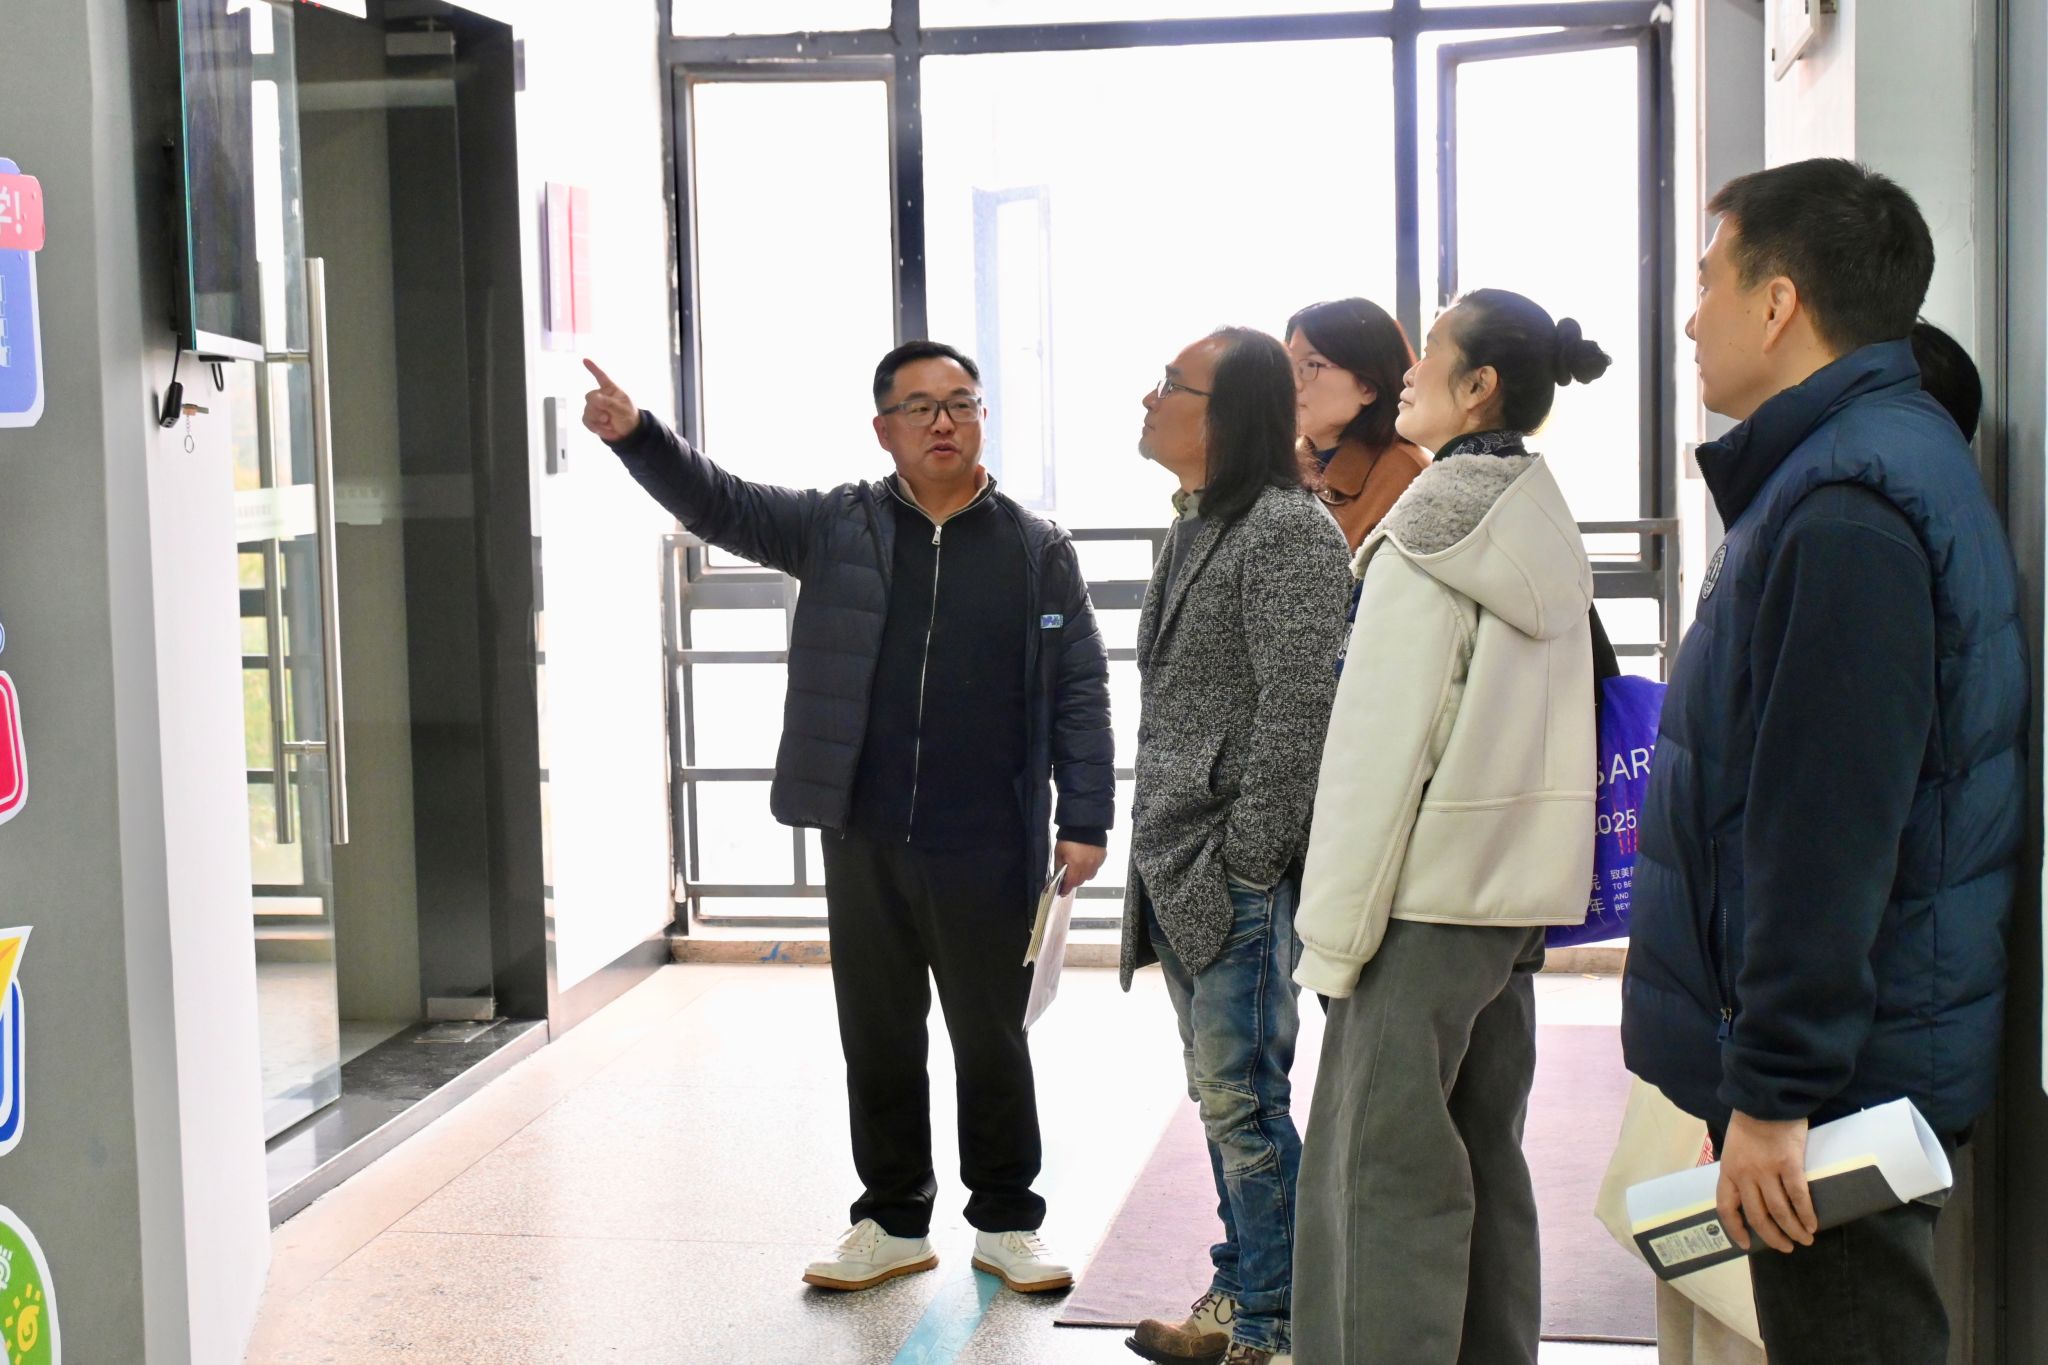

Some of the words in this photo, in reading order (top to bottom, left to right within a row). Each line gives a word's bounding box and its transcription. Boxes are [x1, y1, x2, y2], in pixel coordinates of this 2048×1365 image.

[1598, 744, 1655, 786] AR
[1595, 808, 1637, 835] 025
[1612, 882, 1622, 890] TO
[1614, 892, 1629, 900] AND
[1615, 902, 1631, 910] BEY
